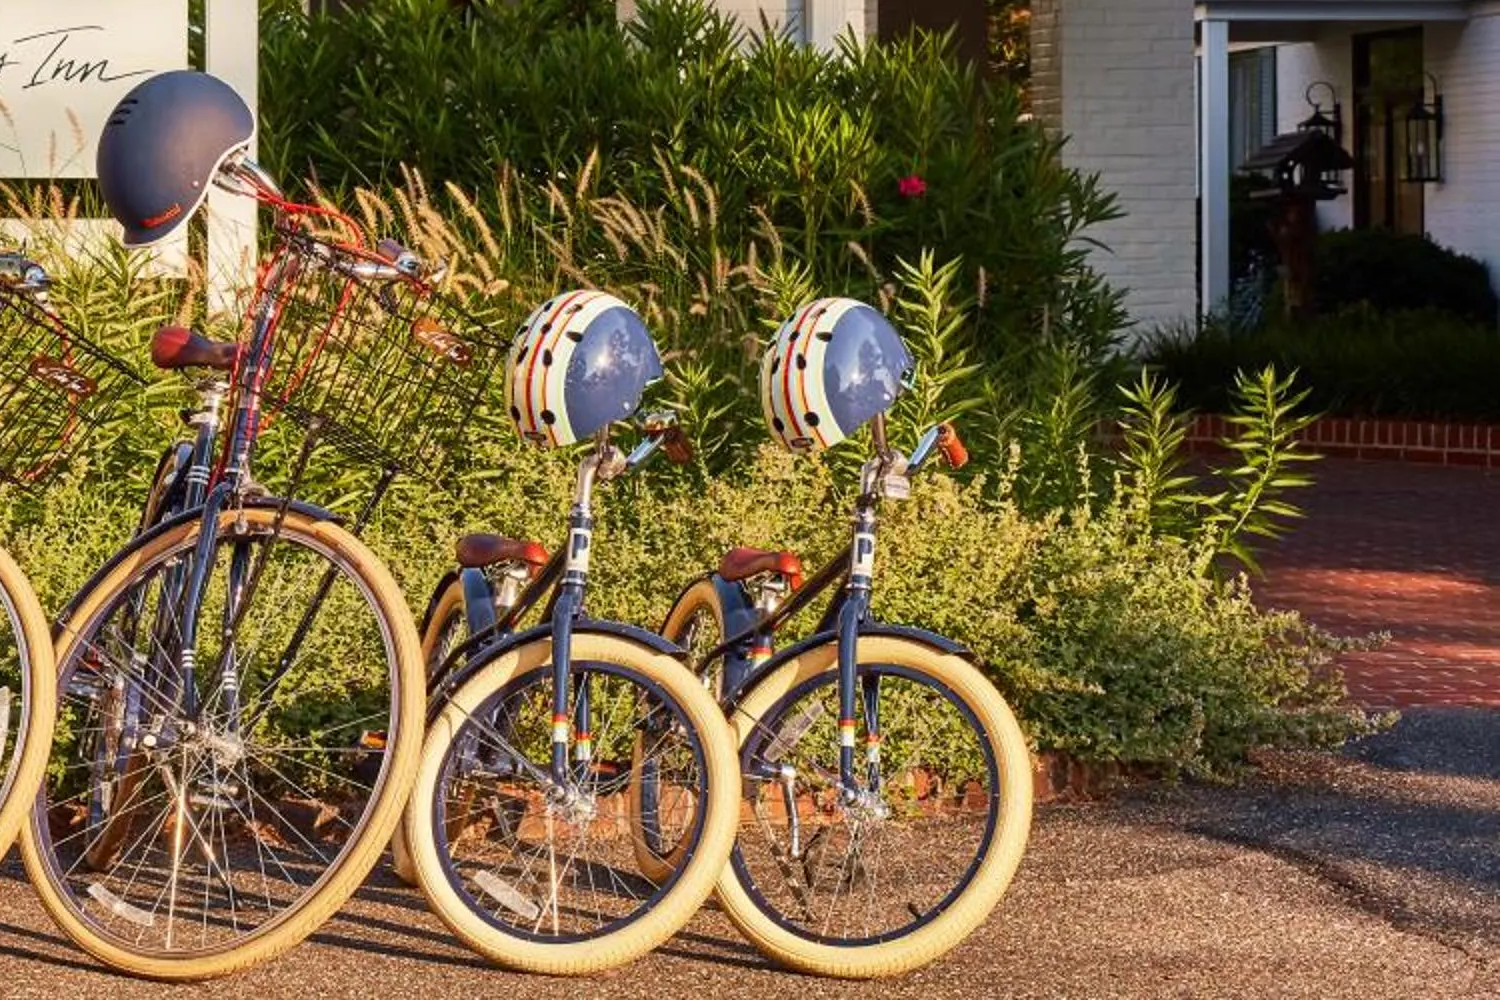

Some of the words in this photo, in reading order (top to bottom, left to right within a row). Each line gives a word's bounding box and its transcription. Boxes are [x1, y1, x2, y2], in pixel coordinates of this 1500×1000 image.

[13, 25, 155, 90] Inn
[572, 533, 589, 560] P
[857, 537, 873, 564] P
